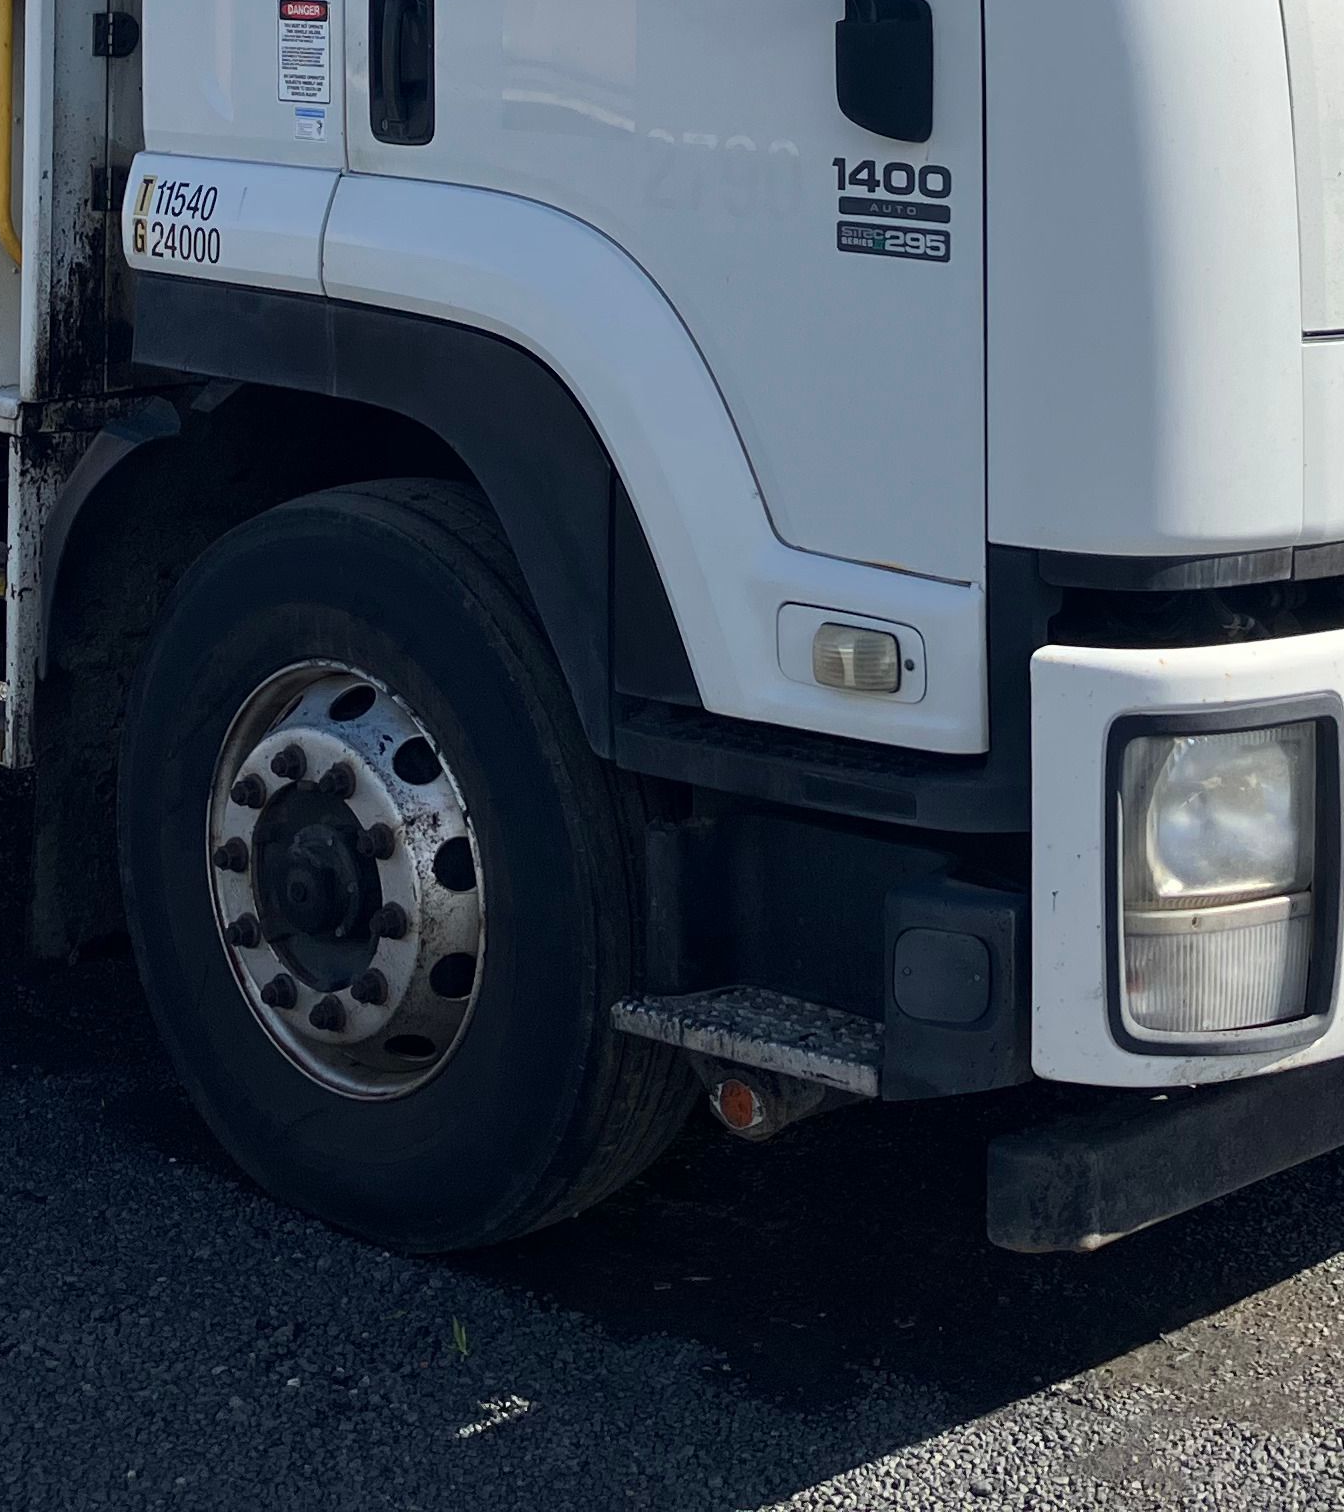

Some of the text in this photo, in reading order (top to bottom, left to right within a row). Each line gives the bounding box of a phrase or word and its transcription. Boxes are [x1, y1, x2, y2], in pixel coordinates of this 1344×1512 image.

[287, 3, 321, 16] DANGER
[832, 157, 952, 199] 1400
[138, 178, 218, 221] T 11540
[869, 202, 917, 216] AUTO
[134, 219, 221, 264] G 24000
[884, 229, 947, 257] 295
